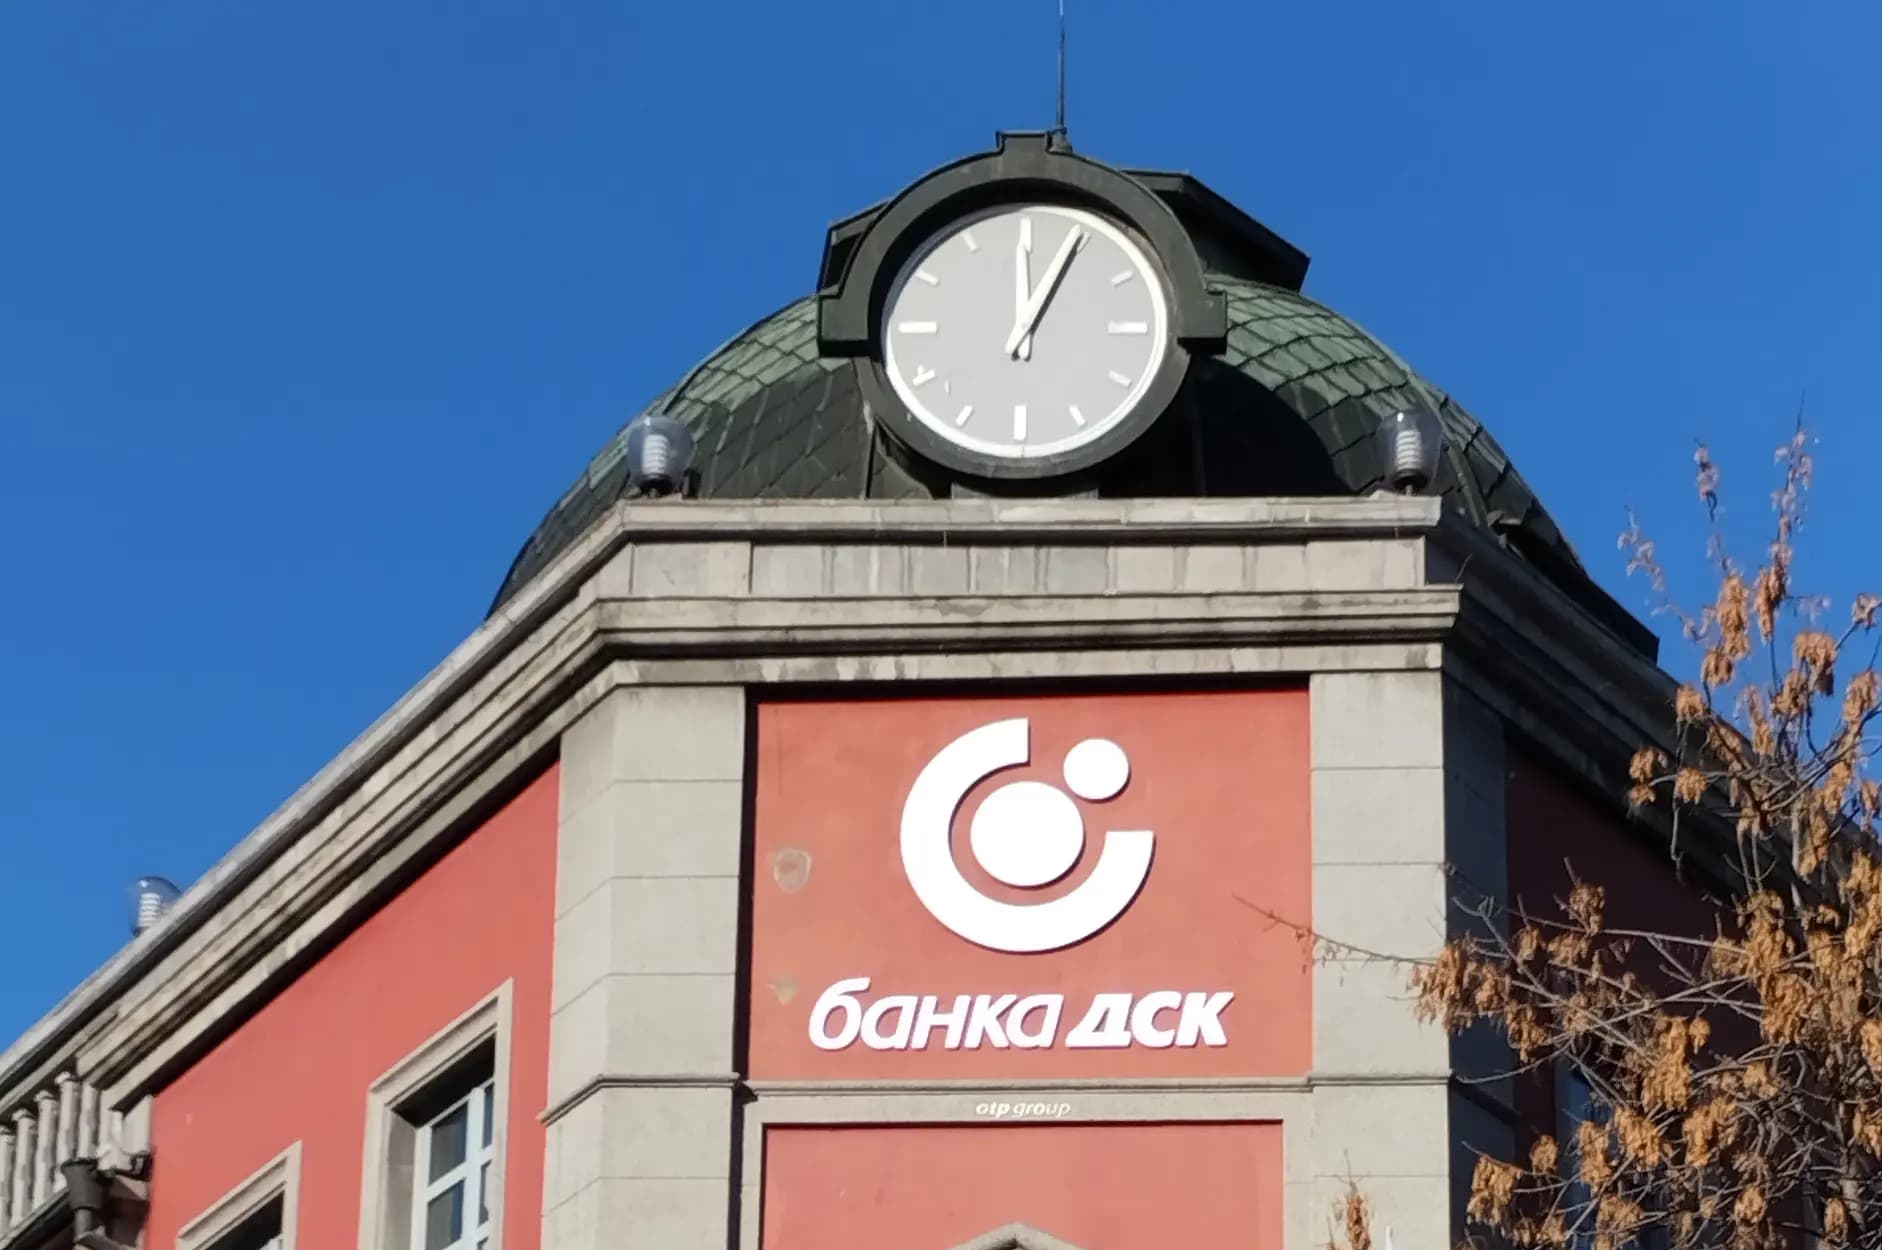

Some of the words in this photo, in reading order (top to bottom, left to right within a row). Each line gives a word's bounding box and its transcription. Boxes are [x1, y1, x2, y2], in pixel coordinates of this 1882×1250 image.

[808, 976, 1065, 1050] банка
[975, 1100, 1011, 1119] otp
[1013, 1102, 1071, 1119] group
